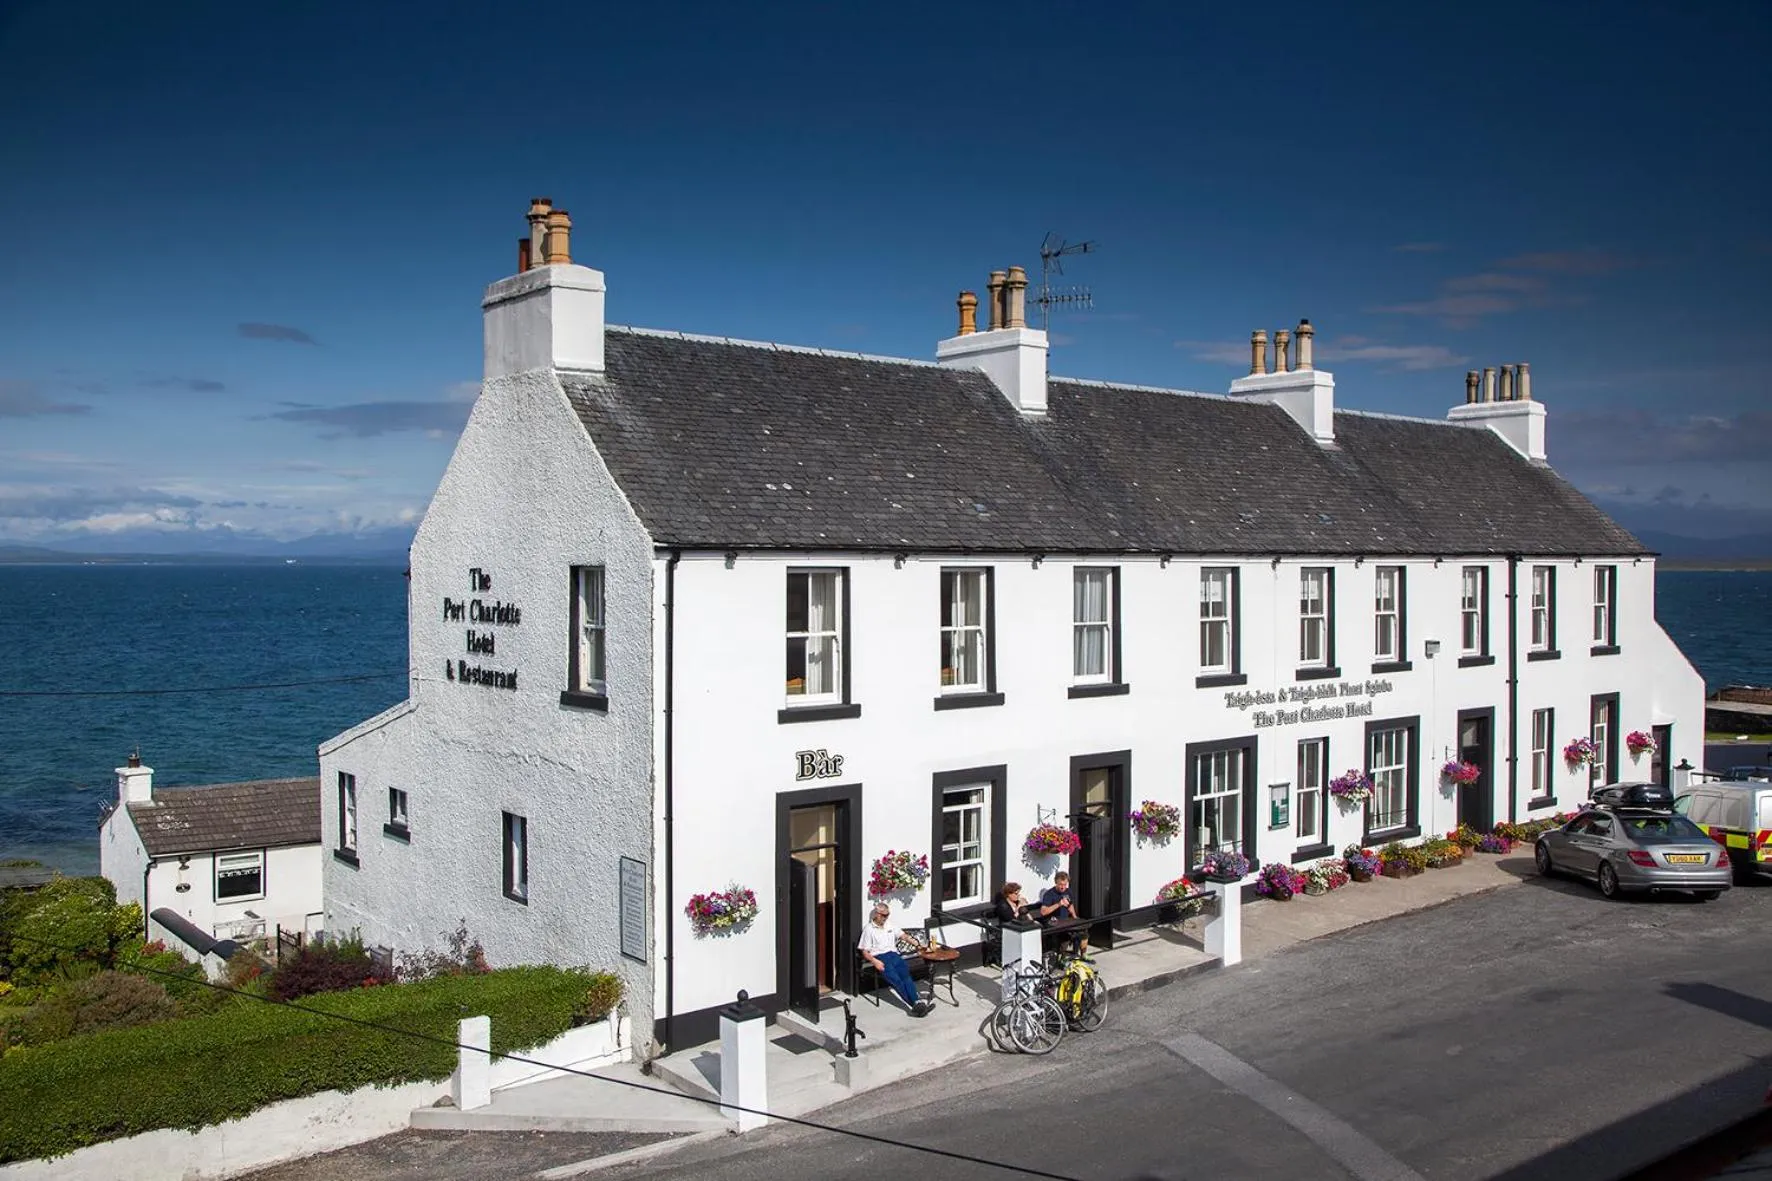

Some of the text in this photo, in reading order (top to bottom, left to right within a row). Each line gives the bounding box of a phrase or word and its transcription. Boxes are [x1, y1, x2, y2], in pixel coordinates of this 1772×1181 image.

[469, 567, 492, 592] The
[443, 597, 521, 626] Port Charlotte
[467, 631, 495, 655] Hotel
[458, 659, 518, 691] Restaurant
[1278, 687, 1288, 703] &
[1252, 701, 1373, 728] The Port Charlotte Hotel
